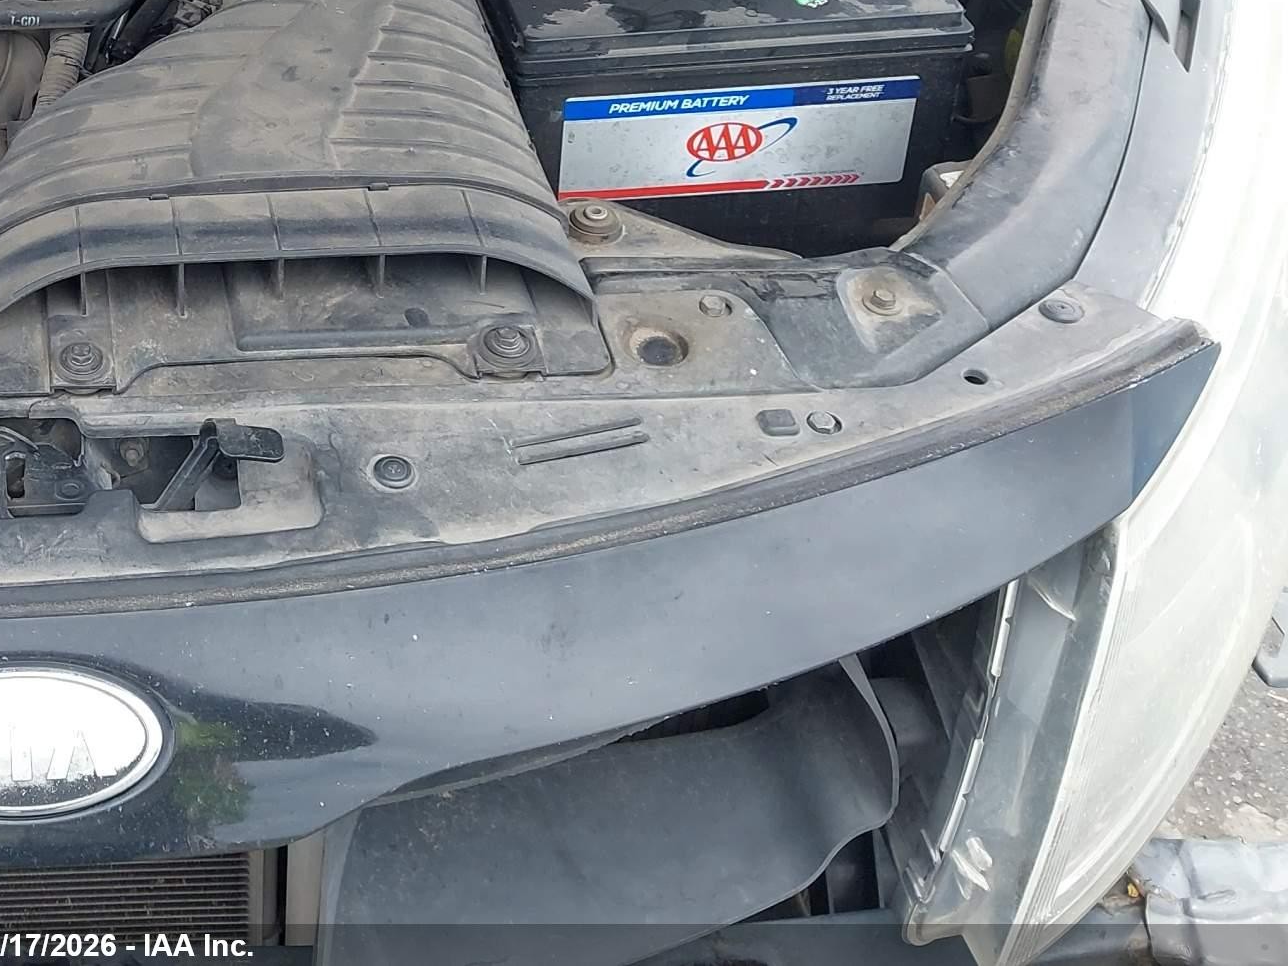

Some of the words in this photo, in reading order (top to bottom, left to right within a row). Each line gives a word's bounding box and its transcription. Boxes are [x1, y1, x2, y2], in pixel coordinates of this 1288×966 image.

[826, 92, 882, 101] REPLACEMENT
[836, 86, 860, 95] YEAR
[861, 84, 885, 93] FREE
[608, 99, 678, 115] PREMIUM
[683, 94, 750, 109] BATTERY
[694, 123, 758, 160] AAA
